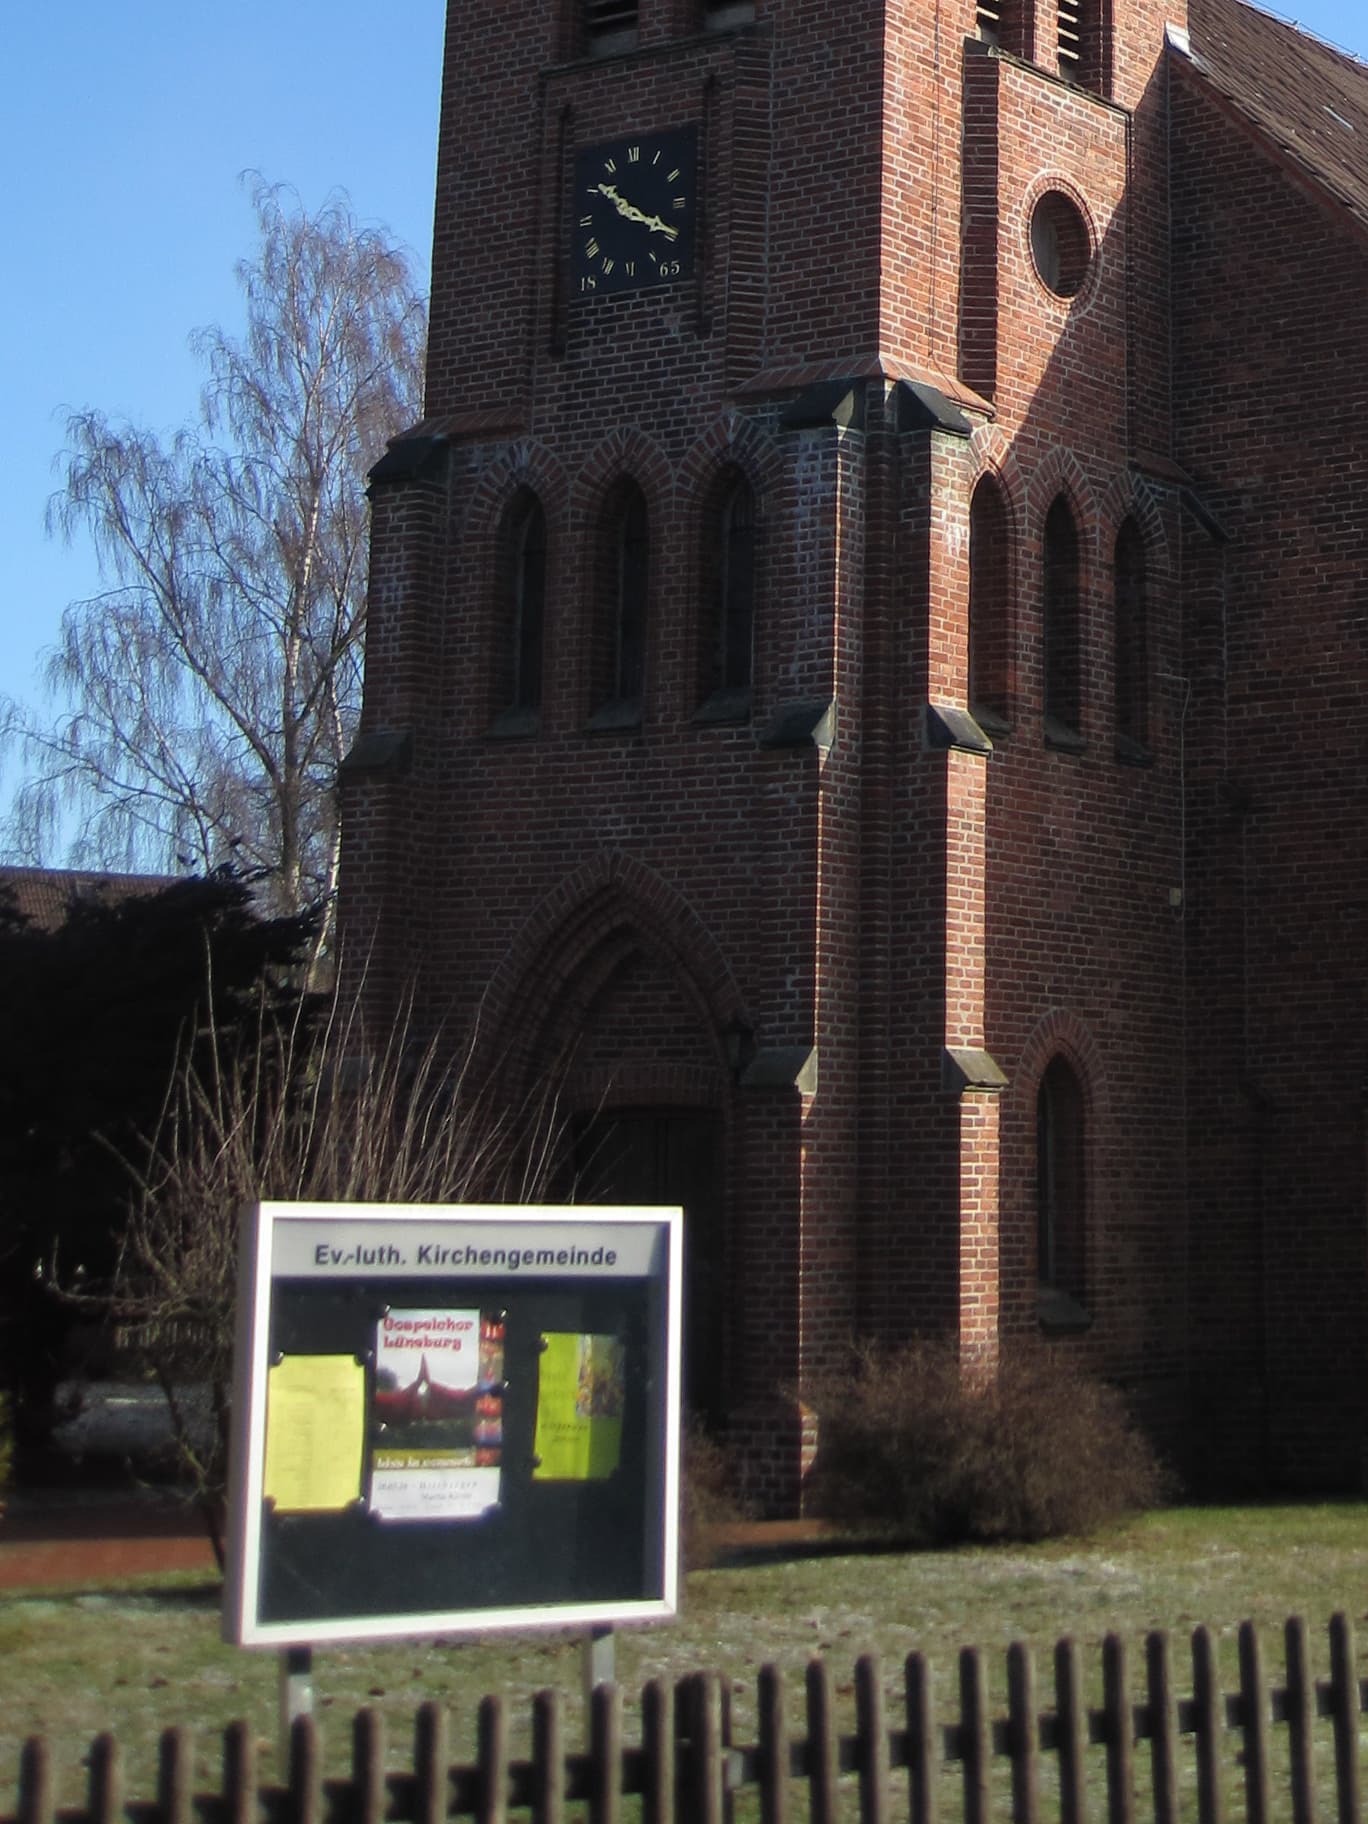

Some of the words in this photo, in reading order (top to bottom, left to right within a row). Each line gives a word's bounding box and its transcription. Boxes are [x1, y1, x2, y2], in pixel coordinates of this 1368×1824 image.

[659, 259, 681, 277] 65
[314, 1244, 408, 1266] Ev.-luth.
[417, 1244, 618, 1270] Kirchengemeinde
[383, 1316, 474, 1334] Gospelchor
[383, 1335, 463, 1352] Lüneburg
